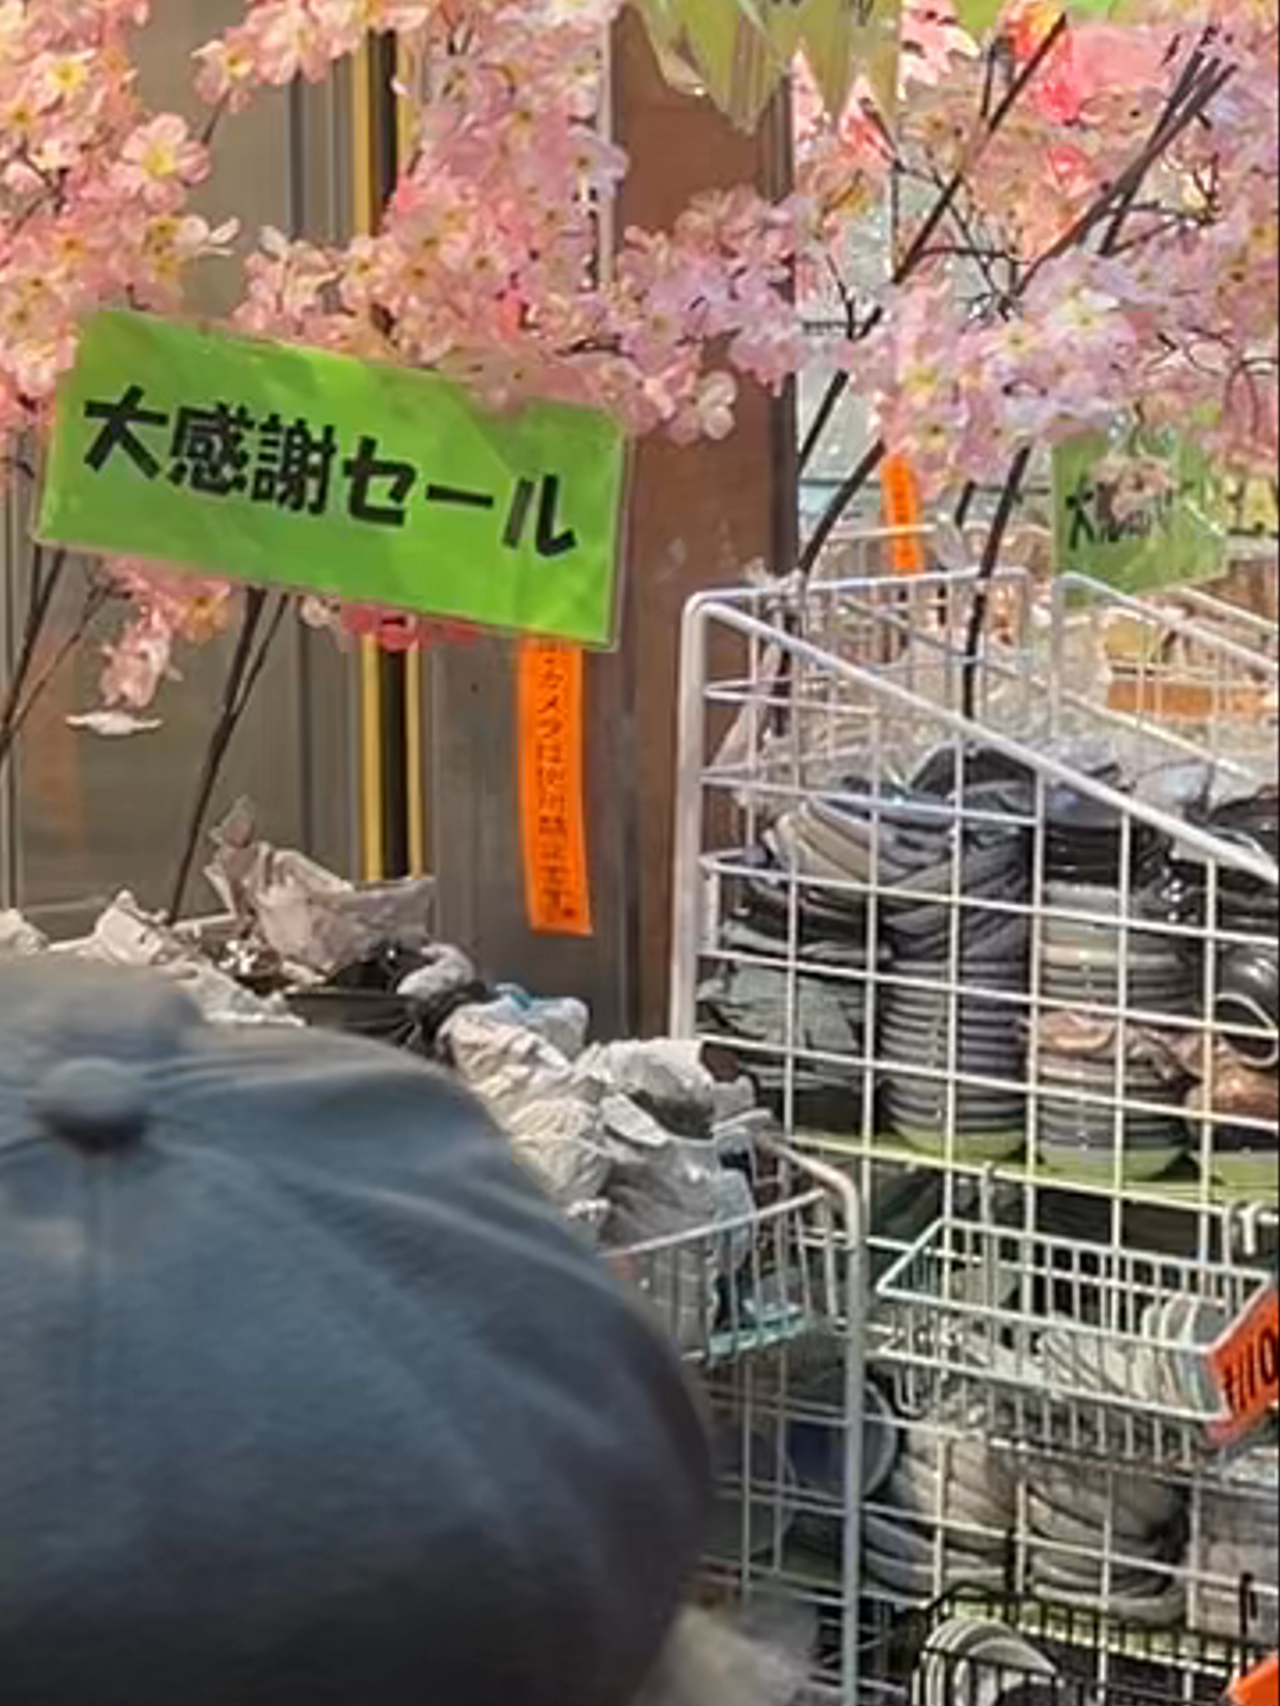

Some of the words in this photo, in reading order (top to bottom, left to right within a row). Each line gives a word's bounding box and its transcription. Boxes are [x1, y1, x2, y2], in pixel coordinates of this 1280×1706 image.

[82, 385, 577, 560] 大感謝セール
